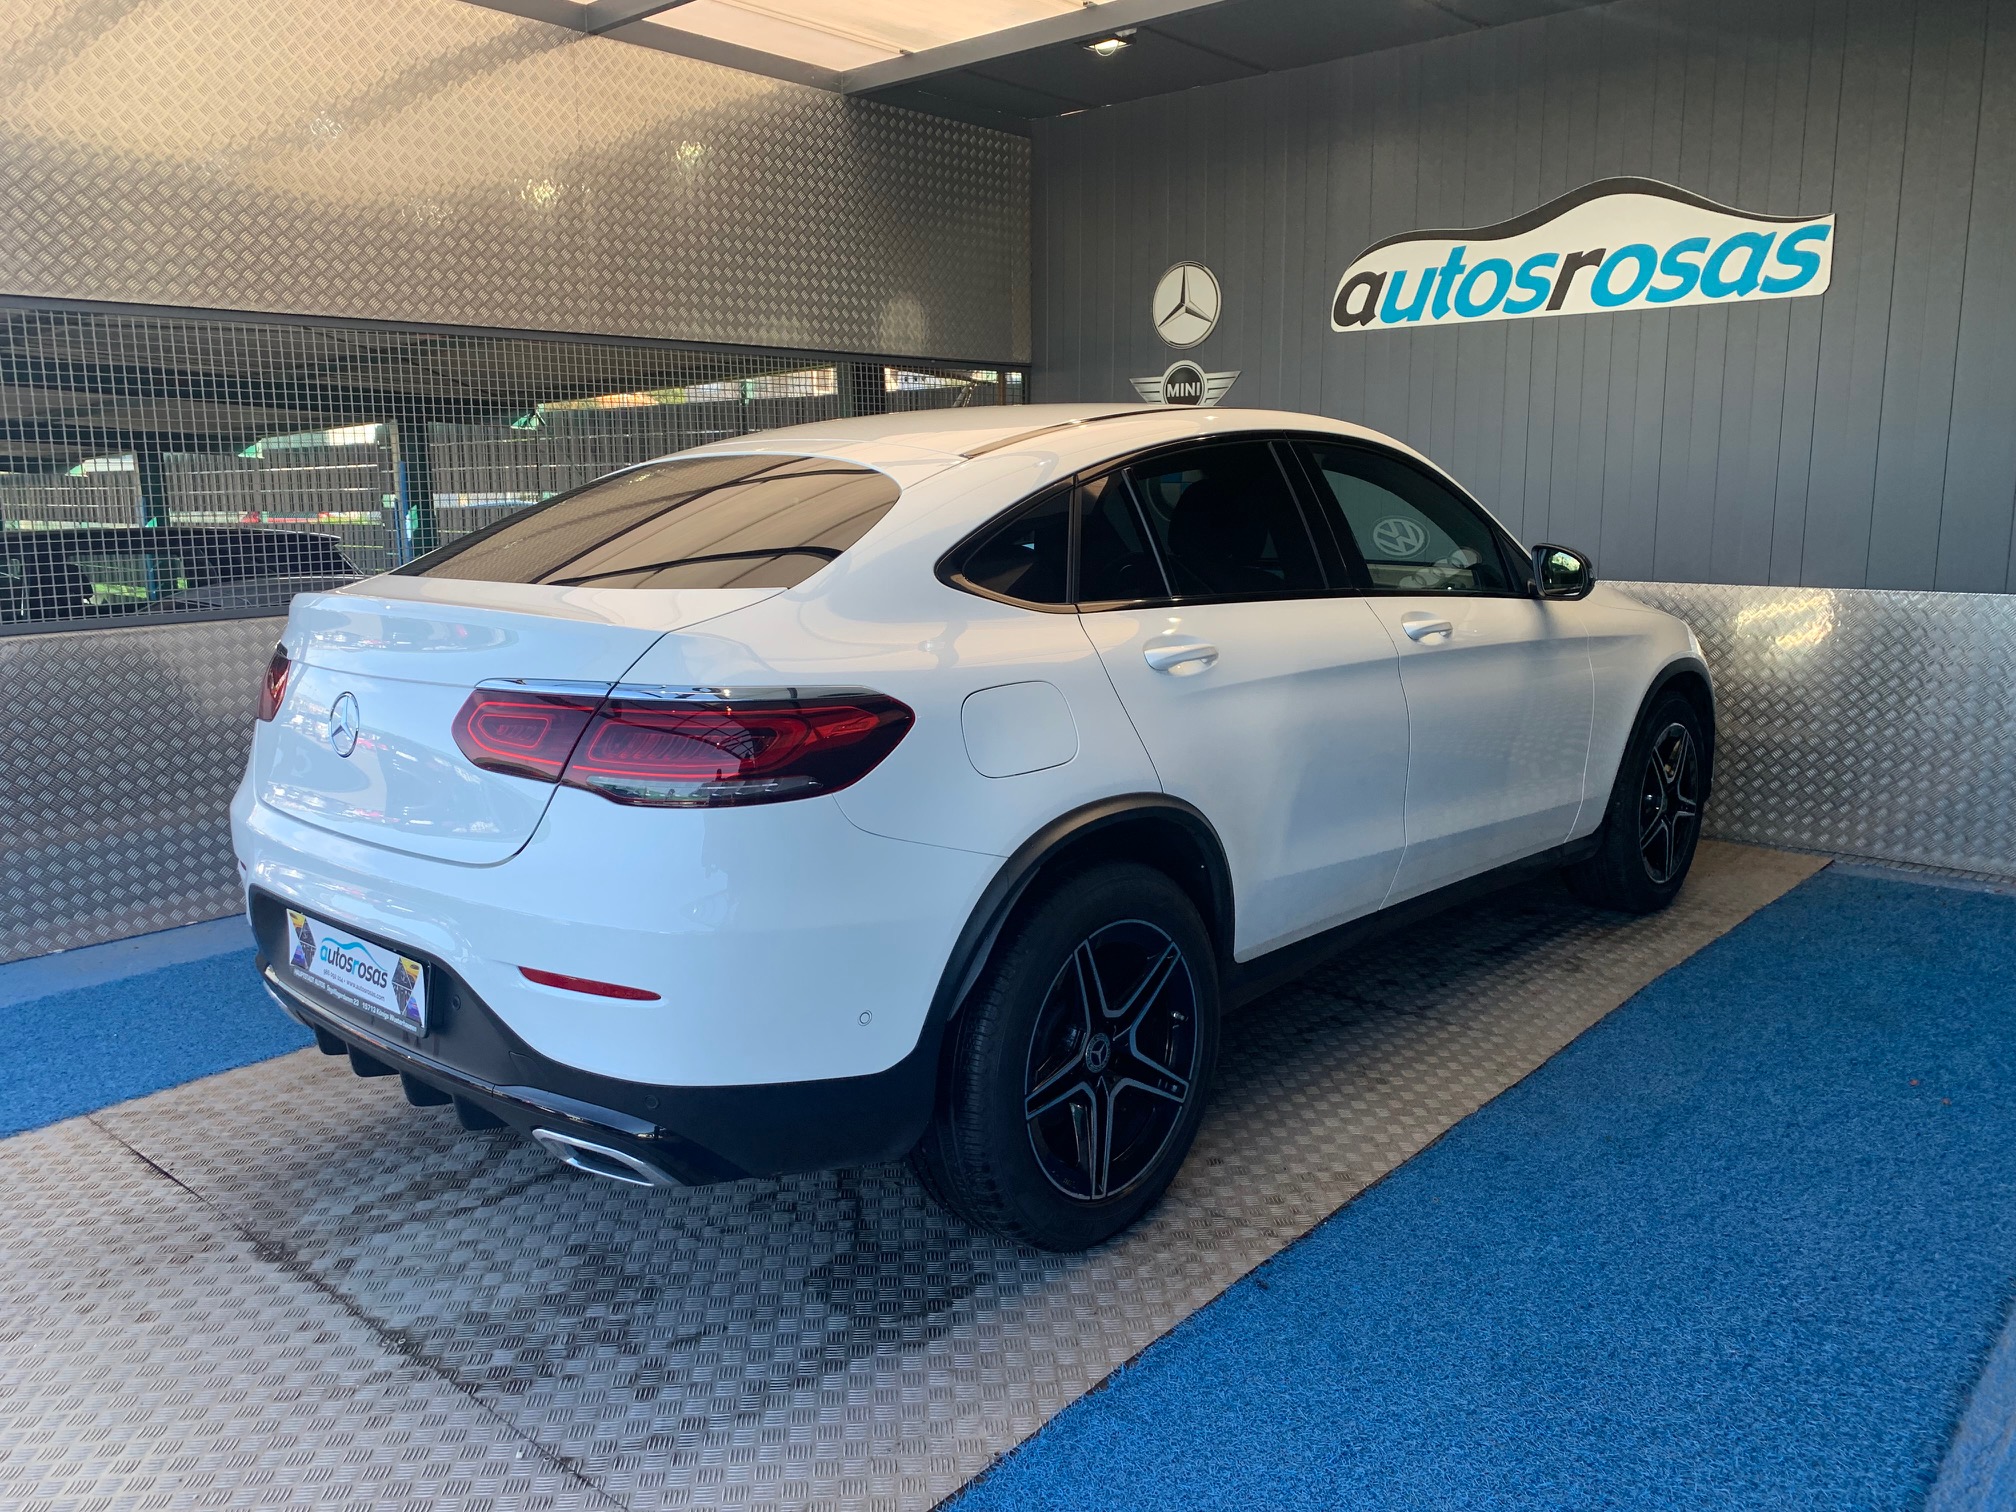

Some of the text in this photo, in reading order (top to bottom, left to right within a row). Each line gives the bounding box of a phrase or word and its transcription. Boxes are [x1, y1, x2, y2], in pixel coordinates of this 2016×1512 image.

[1335, 225, 1832, 327] autosrosas
[1166, 382, 1201, 397] MINI
[320, 945, 388, 988] autosrosas
[362, 1002, 376, 1013] 15713
